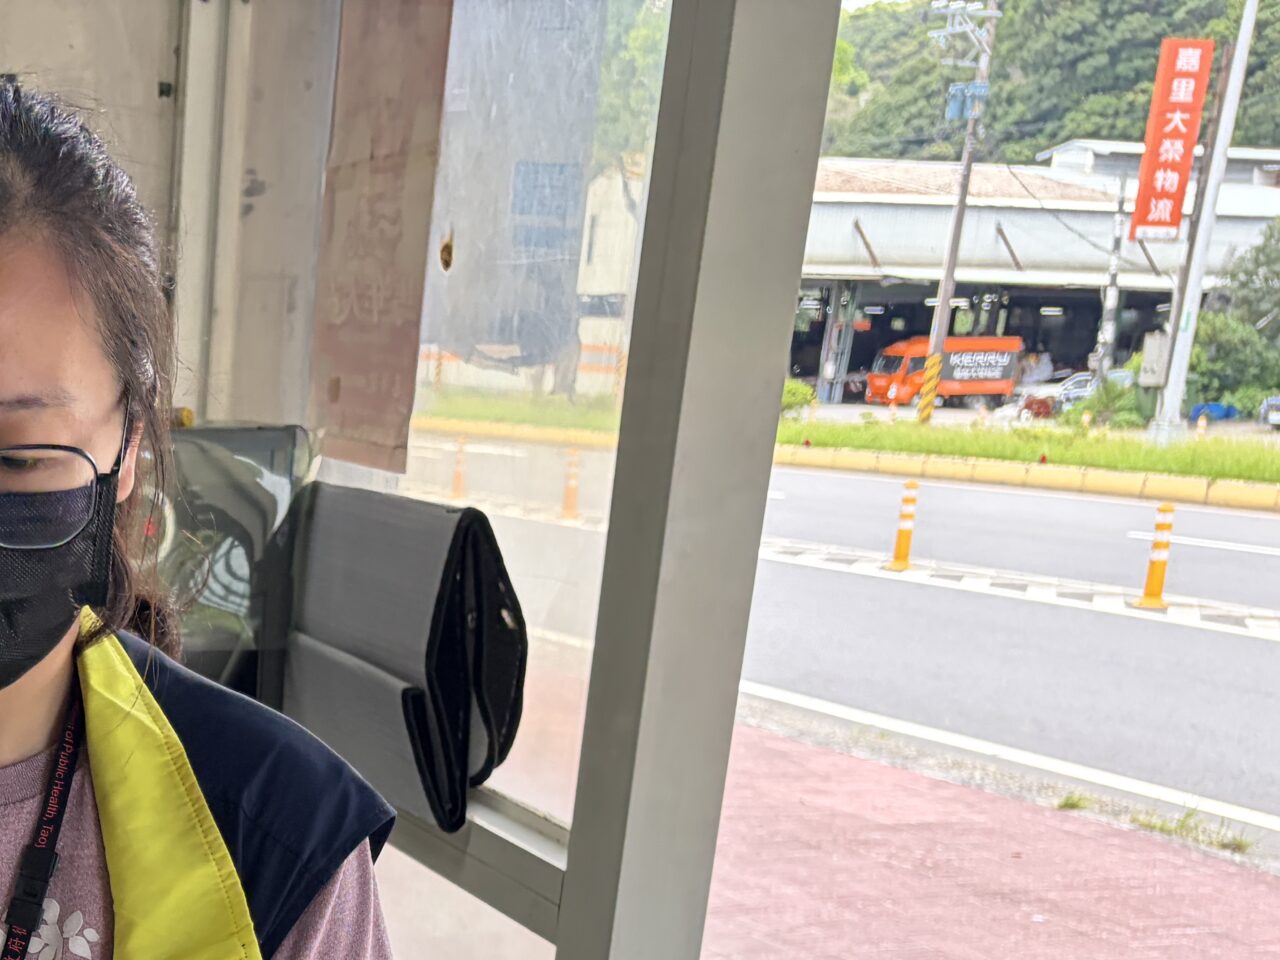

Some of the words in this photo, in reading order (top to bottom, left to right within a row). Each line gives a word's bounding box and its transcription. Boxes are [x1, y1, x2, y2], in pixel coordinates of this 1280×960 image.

[1147, 47, 1202, 222] 嘉里大榮物流
[55, 744, 73, 778] Public
